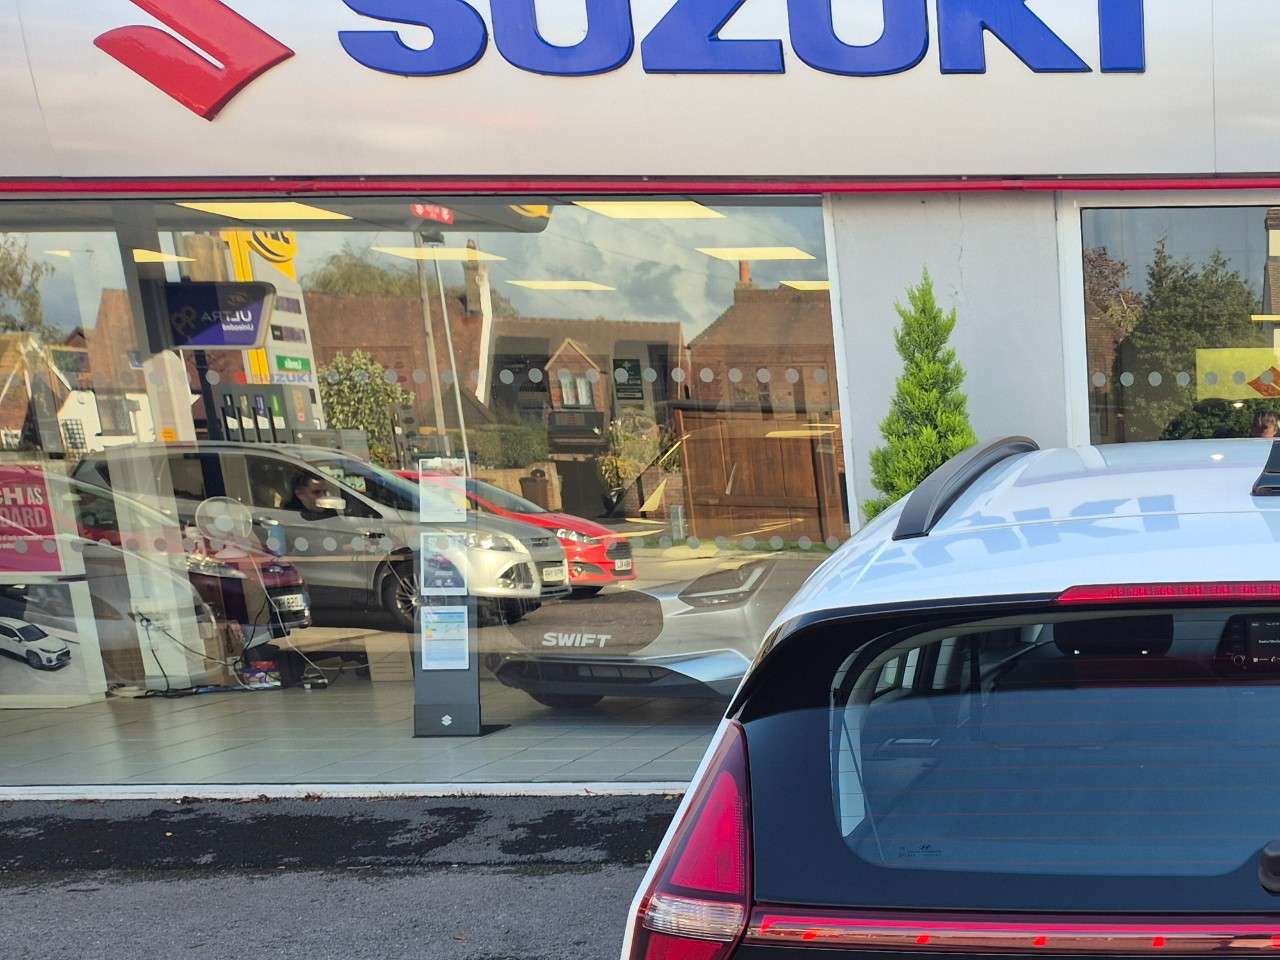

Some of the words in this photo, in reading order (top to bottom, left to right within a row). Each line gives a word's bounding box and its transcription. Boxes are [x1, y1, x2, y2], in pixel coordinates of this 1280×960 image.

[338, 0, 1145, 77] SUZUKI
[27, 487, 44, 505] AS
[542, 631, 612, 648] SWIFT
